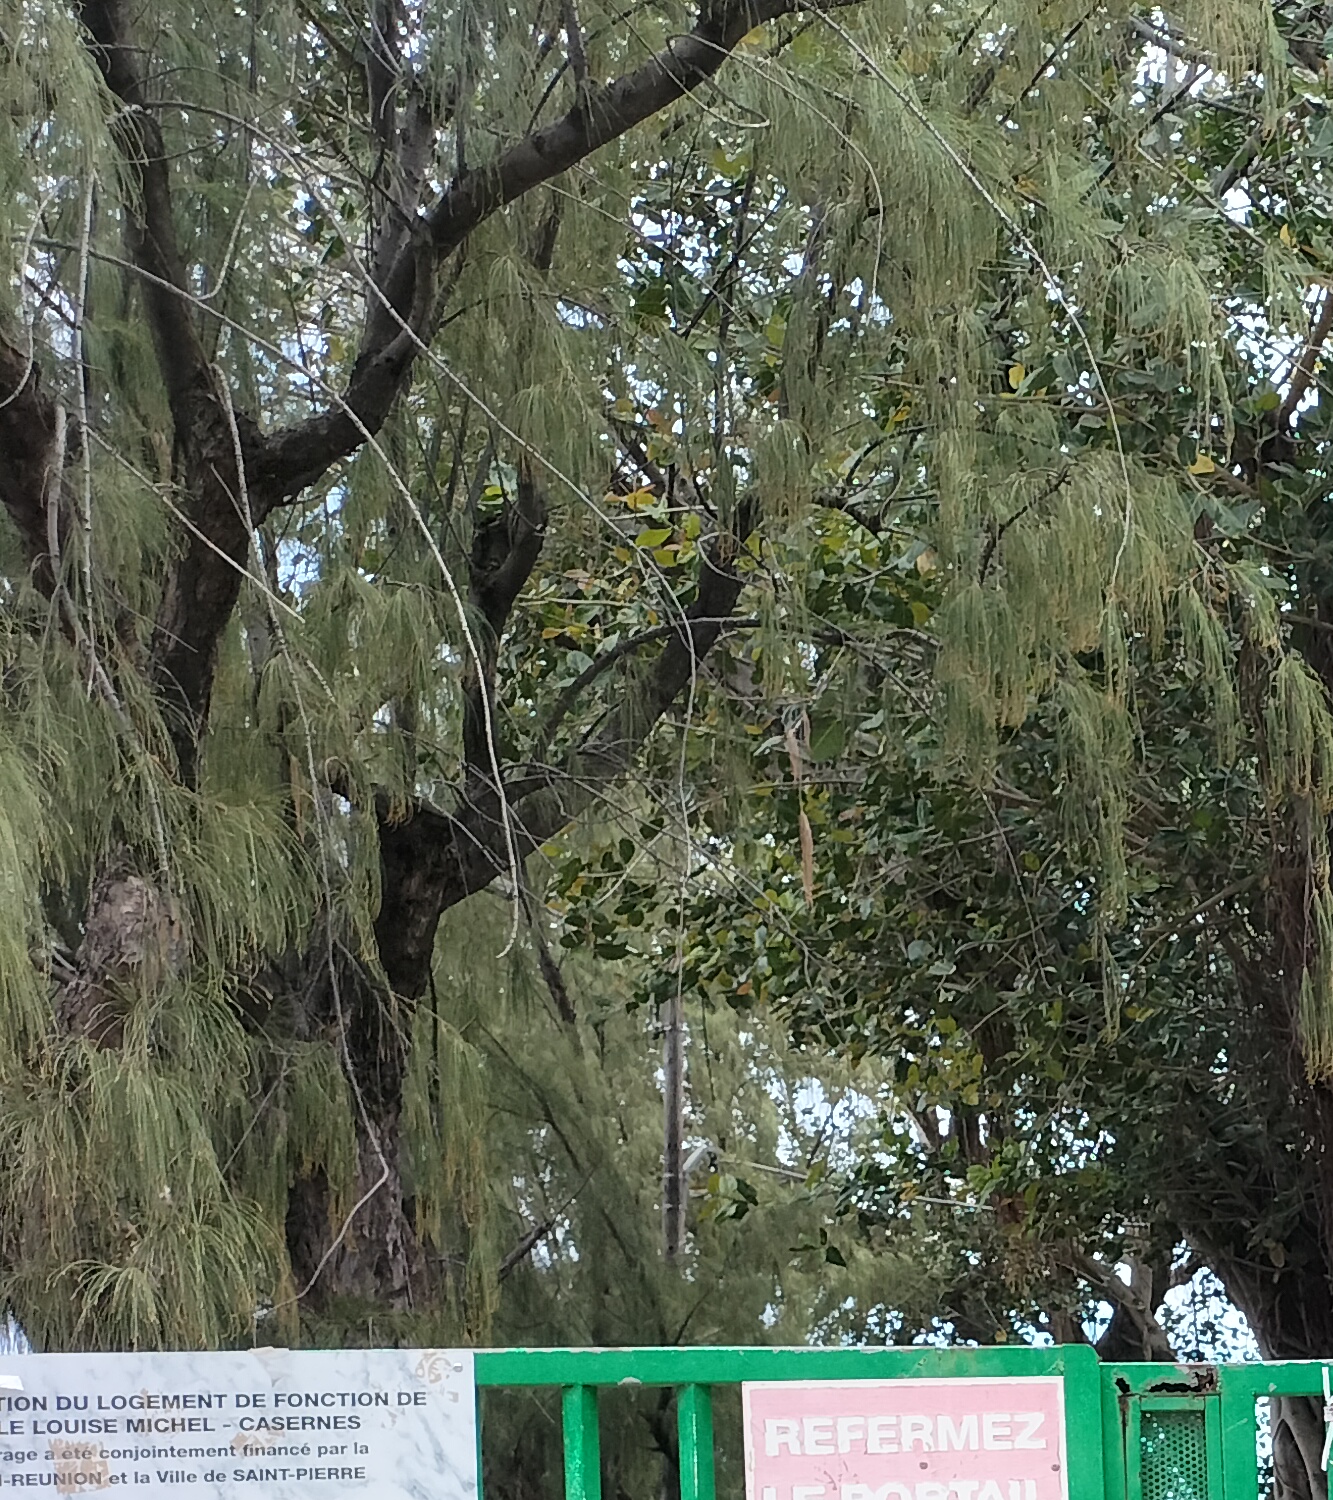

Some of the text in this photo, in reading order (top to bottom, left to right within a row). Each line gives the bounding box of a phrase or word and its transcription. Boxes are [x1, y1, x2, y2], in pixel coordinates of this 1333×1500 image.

[56, 1395, 89, 1411] DU
[97, 1394, 227, 1411] LOGEMENT
[235, 1393, 267, 1408] DE
[274, 1392, 389, 1408] FONCTION
[397, 1391, 427, 1406] DE
[33, 1419, 118, 1435] LOUISE
[126, 1417, 216, 1433] MICHEL
[239, 1415, 361, 1431] CASERNES
[763, 1412, 1048, 1457] REFERMEZ
[0, 1442, 369, 1464] age a été conjointement financé par la
[109, 1472, 127, 1485] et
[134, 1471, 151, 1484] la
[156, 1470, 198, 1483] Ville
[204, 1469, 227, 1483] de
[233, 1467, 366, 1482] SAINT-PIERRE
